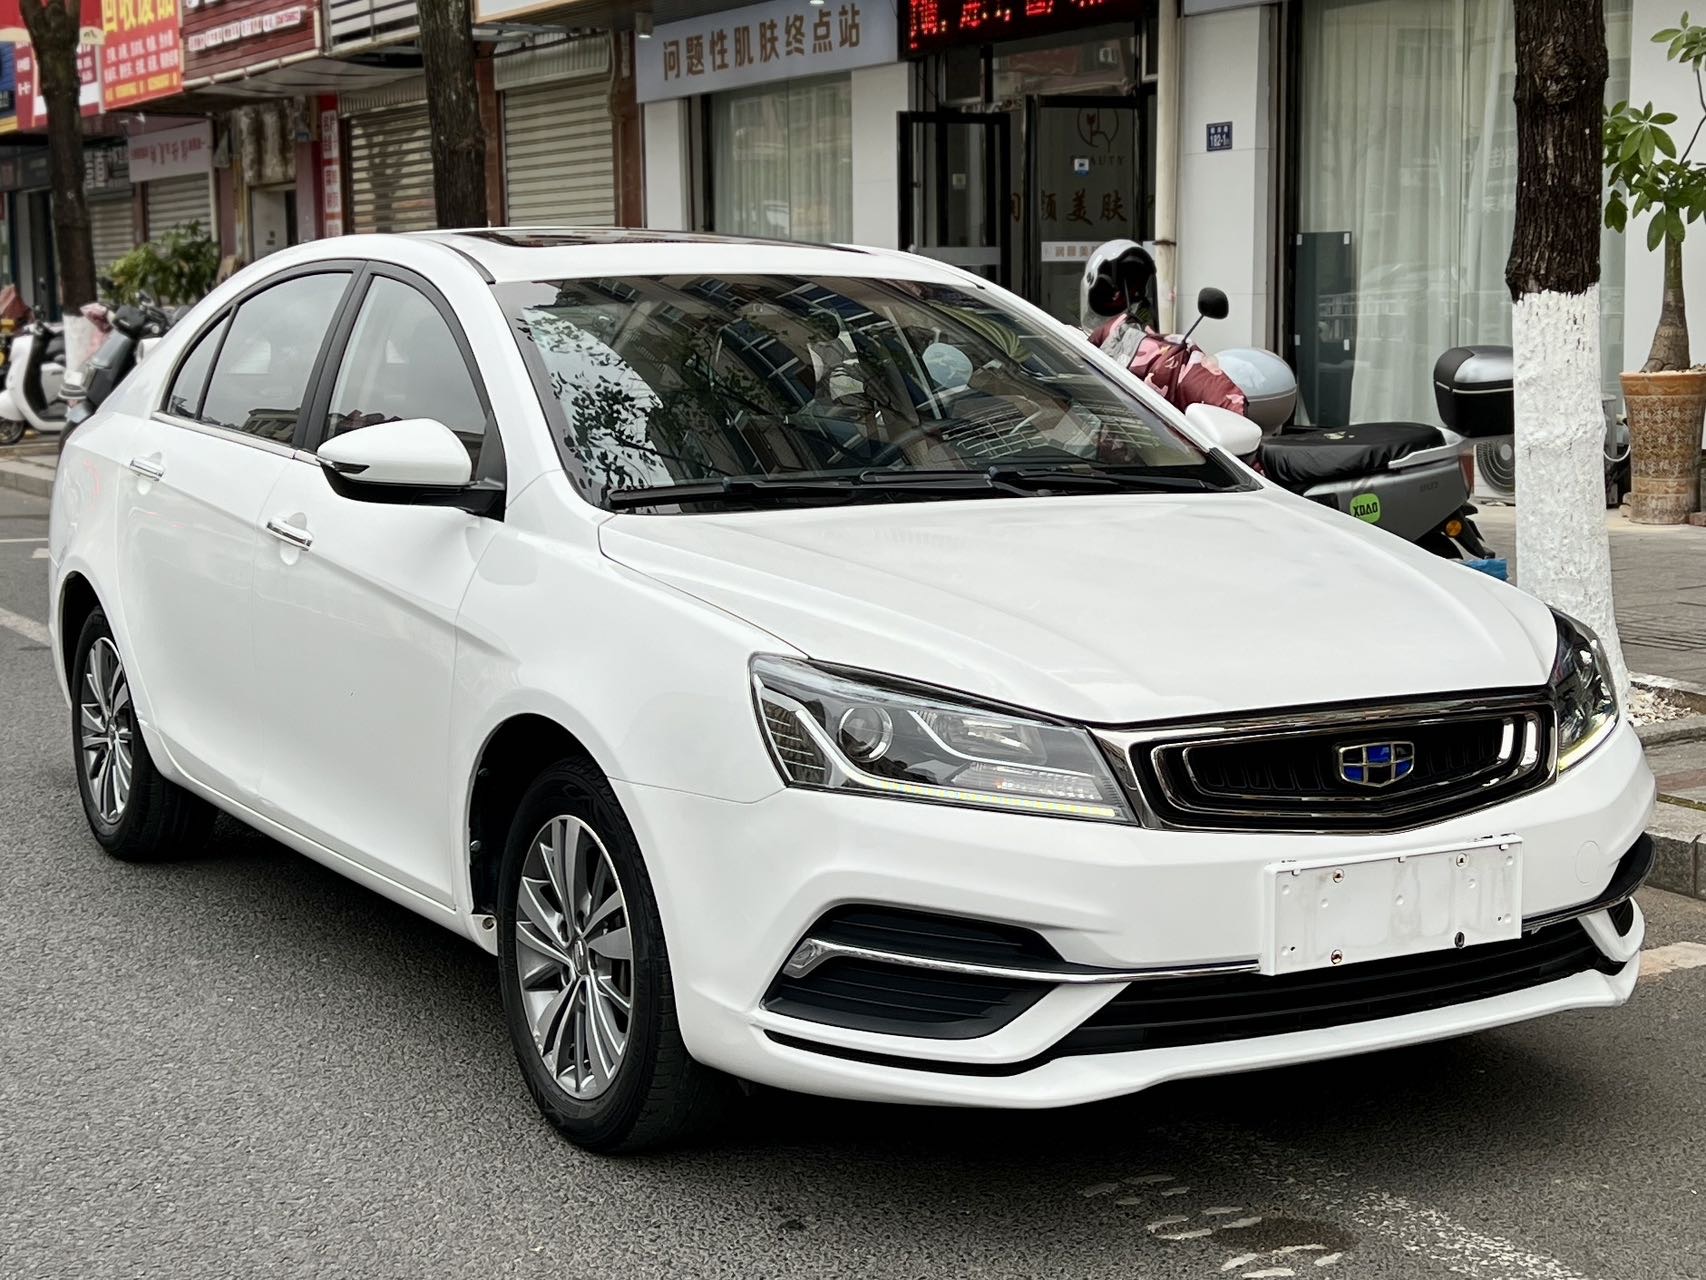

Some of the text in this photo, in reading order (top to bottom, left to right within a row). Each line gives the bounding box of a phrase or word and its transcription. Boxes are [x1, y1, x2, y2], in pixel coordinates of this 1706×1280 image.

[663, 3, 861, 81] 问题性肌肤终点站
[1070, 154, 1126, 166] BAUTY
